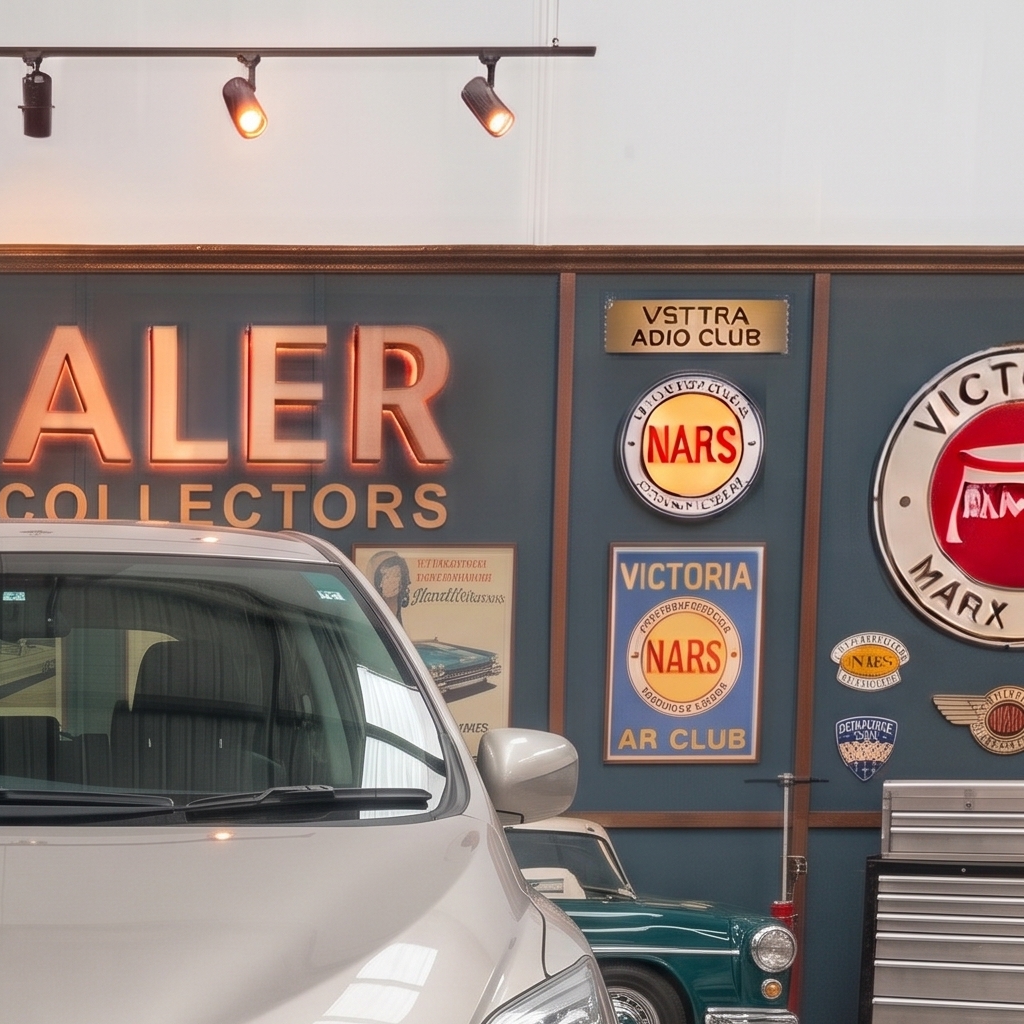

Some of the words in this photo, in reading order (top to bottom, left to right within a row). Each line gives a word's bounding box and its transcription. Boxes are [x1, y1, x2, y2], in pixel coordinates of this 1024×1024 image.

[642, 305, 750, 326] VSTTRA
[631, 328, 691, 347] ADIO
[698, 327, 762, 347] CLUB
[913, 360, 1024, 436] VICT
[647, 424, 738, 464] NARS
[619, 562, 753, 591] VICTORIA
[908, 553, 1009, 630] MARX
[646, 639, 722, 674] NARS
[617, 728, 659, 750] AR
[669, 728, 747, 750] CLUB
